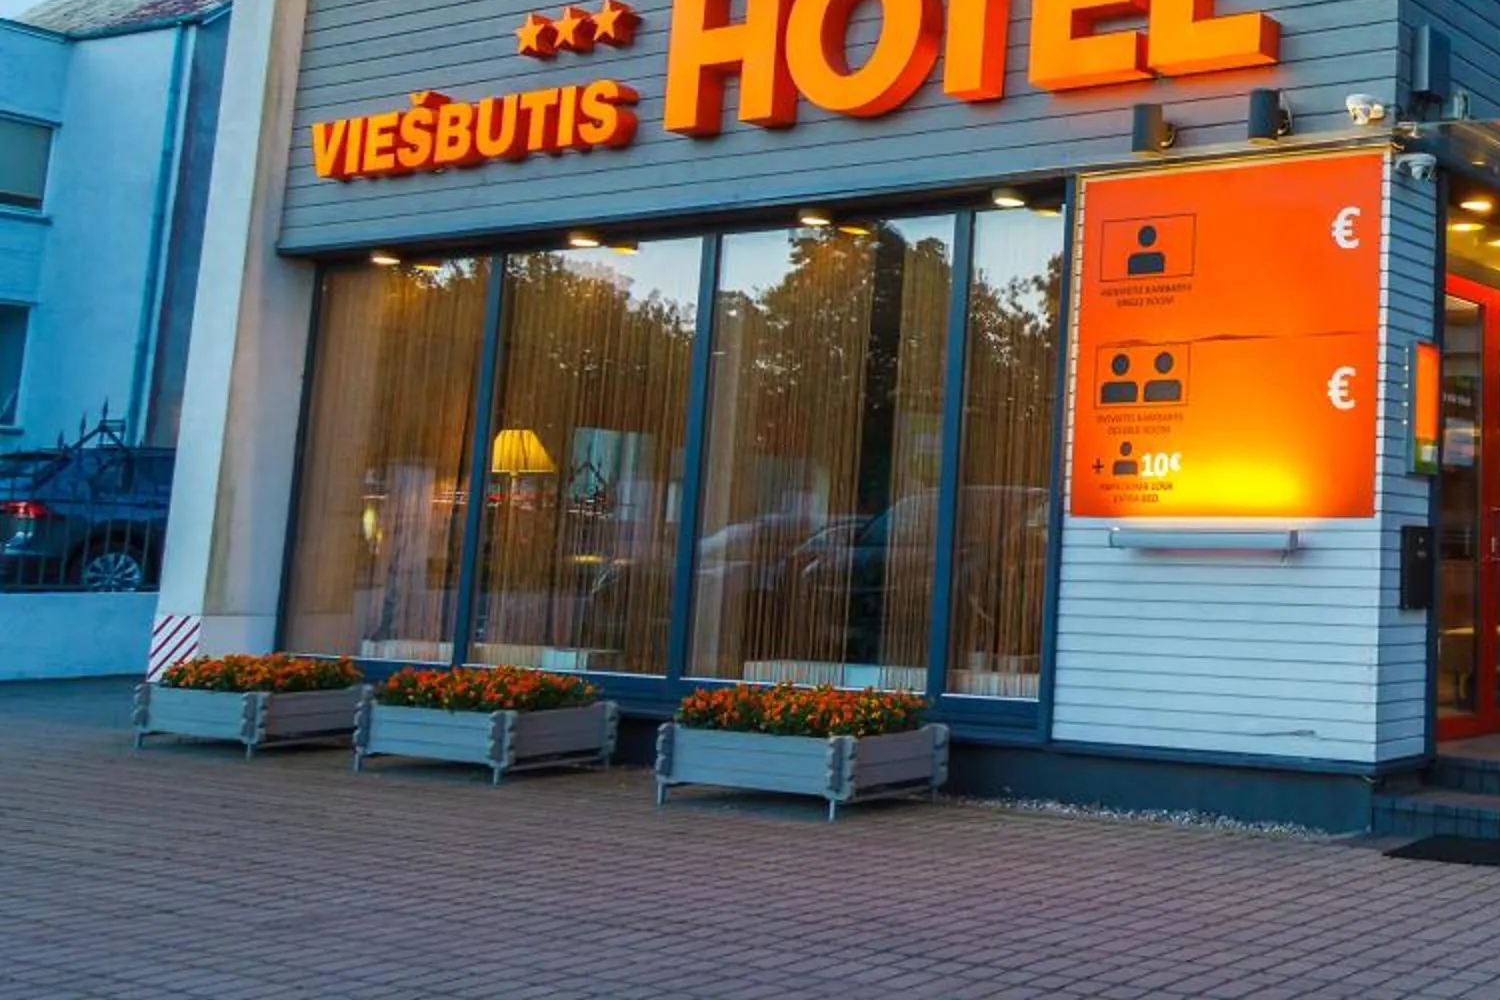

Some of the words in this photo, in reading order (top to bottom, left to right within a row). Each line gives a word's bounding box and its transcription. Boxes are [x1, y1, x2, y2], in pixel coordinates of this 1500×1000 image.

[311, 78, 636, 181] VIEŠBUTIS
[1330, 206, 1361, 249] €
[1327, 366, 1357, 410] €
[1141, 451, 1182, 478] 10€
